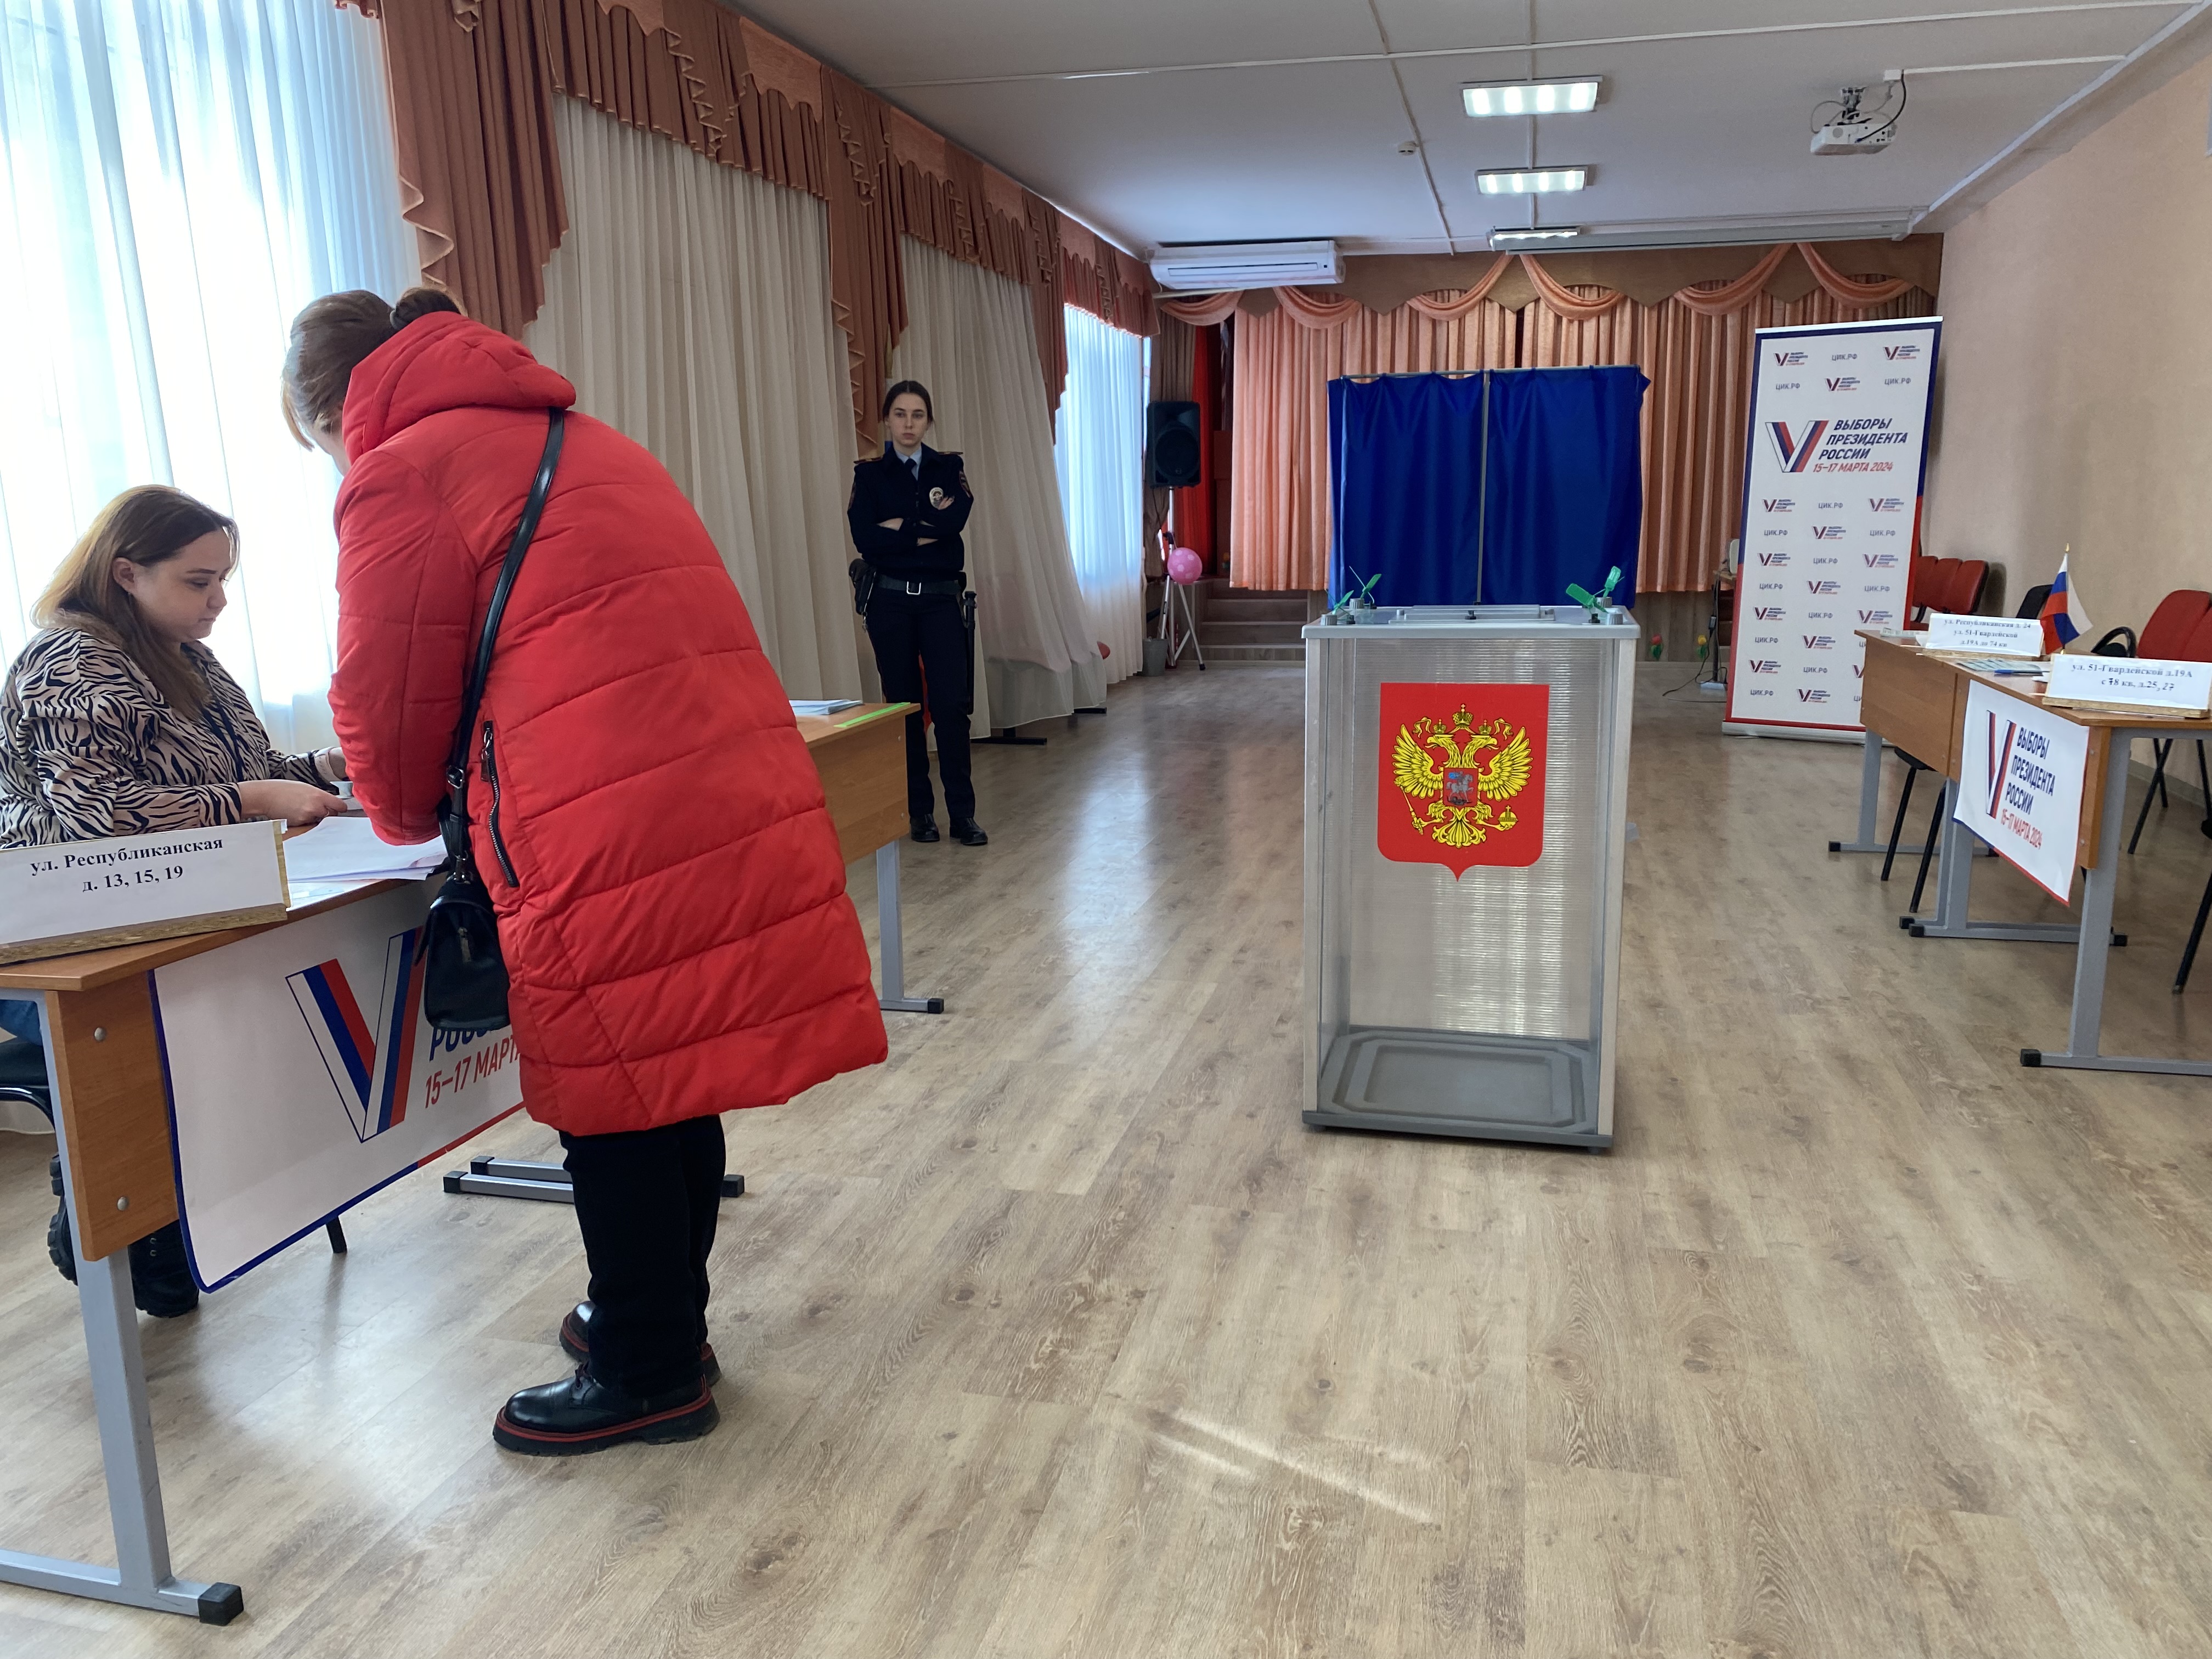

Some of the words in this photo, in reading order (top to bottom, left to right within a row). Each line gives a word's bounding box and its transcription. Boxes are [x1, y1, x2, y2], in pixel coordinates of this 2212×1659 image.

[1831, 353, 1858, 362] ЦИК.РФ
[1775, 382, 1801, 391] ЦИК.РФ
[1884, 377, 1912, 386] ЦИК.РФ
[1833, 418, 1893, 431] ВЫБОРЫ
[1826, 432, 1909, 446] ПРЕЗИДЕНТА
[1818, 448, 1871, 460] РОССИИ
[1838, 462, 1870, 472] МАРТА
[1870, 461, 1893, 472] 2024
[1956, 619, 2014, 628] Республиканская
[2071, 663, 2085, 672] ул.
[2088, 664, 2163, 675] 51-Гвардейской
[2017, 726, 2050, 760] ВЫБОРЫ
[2011, 754, 2056, 796] ПРЕЗИДЕНТА
[2005, 782, 2034, 815] РОССИИ
[2012, 816, 2031, 842] МАРТА
[2029, 827, 2043, 850] 2024
[30, 860, 59, 876] ул.
[64, 838, 223, 868] Республиканская
[82, 879, 98, 893] д.
[104, 874, 129, 889] 13,
[134, 868, 160, 884] 15,
[165, 865, 183, 880] 19
[473, 1034, 520, 1084] МАРТ
